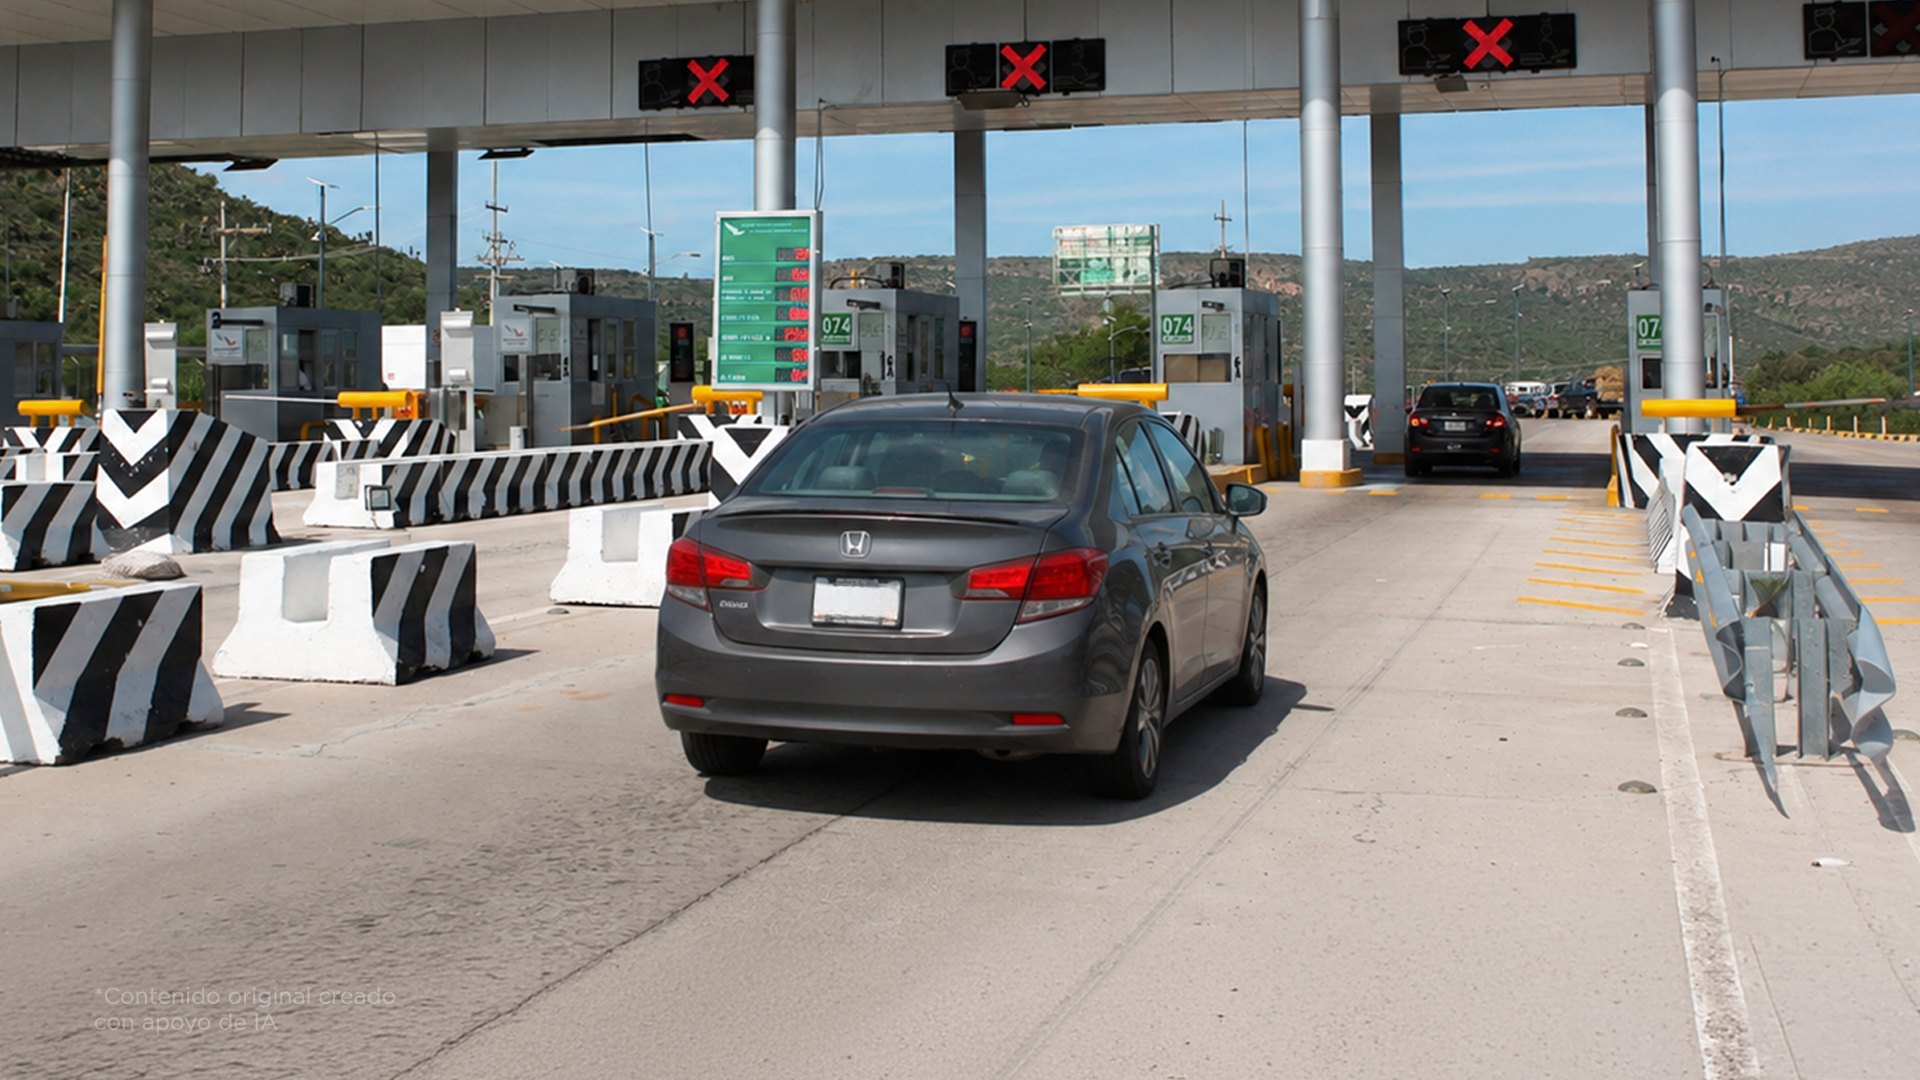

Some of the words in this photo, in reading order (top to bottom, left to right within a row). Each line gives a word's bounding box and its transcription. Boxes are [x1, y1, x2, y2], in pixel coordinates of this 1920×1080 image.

[823, 317, 851, 334] 074
[1163, 317, 1193, 335] 074
[1638, 318, 1661, 337] 07
